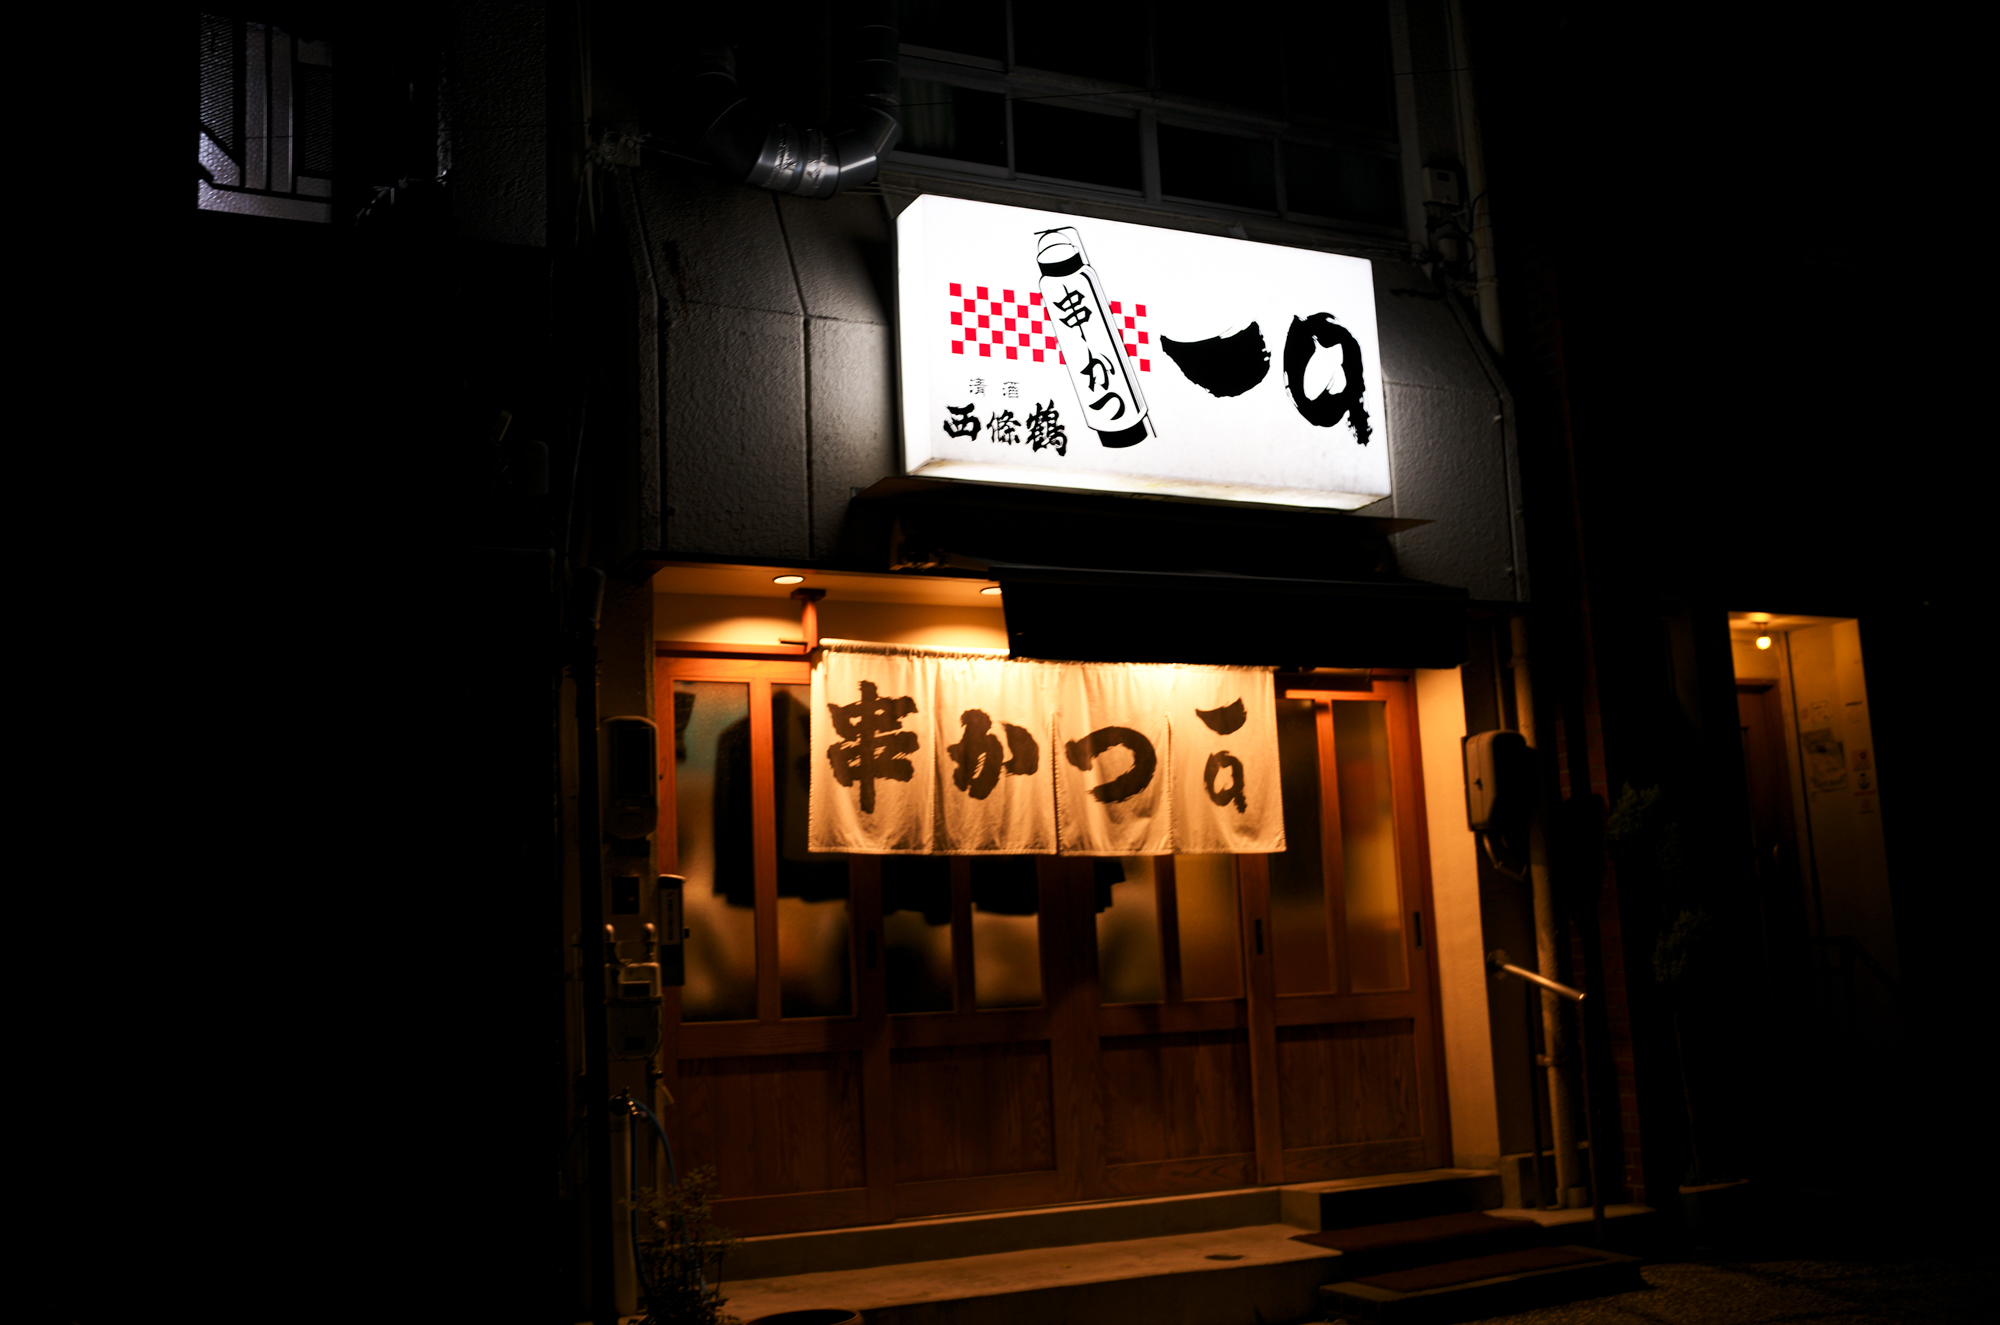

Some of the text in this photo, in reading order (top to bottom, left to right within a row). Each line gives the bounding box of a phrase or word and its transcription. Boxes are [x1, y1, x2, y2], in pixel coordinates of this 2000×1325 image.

[1053, 284, 1125, 421] 串かつ
[943, 398, 1067, 457] 西條鶴
[827, 680, 1157, 814] 串かつ
